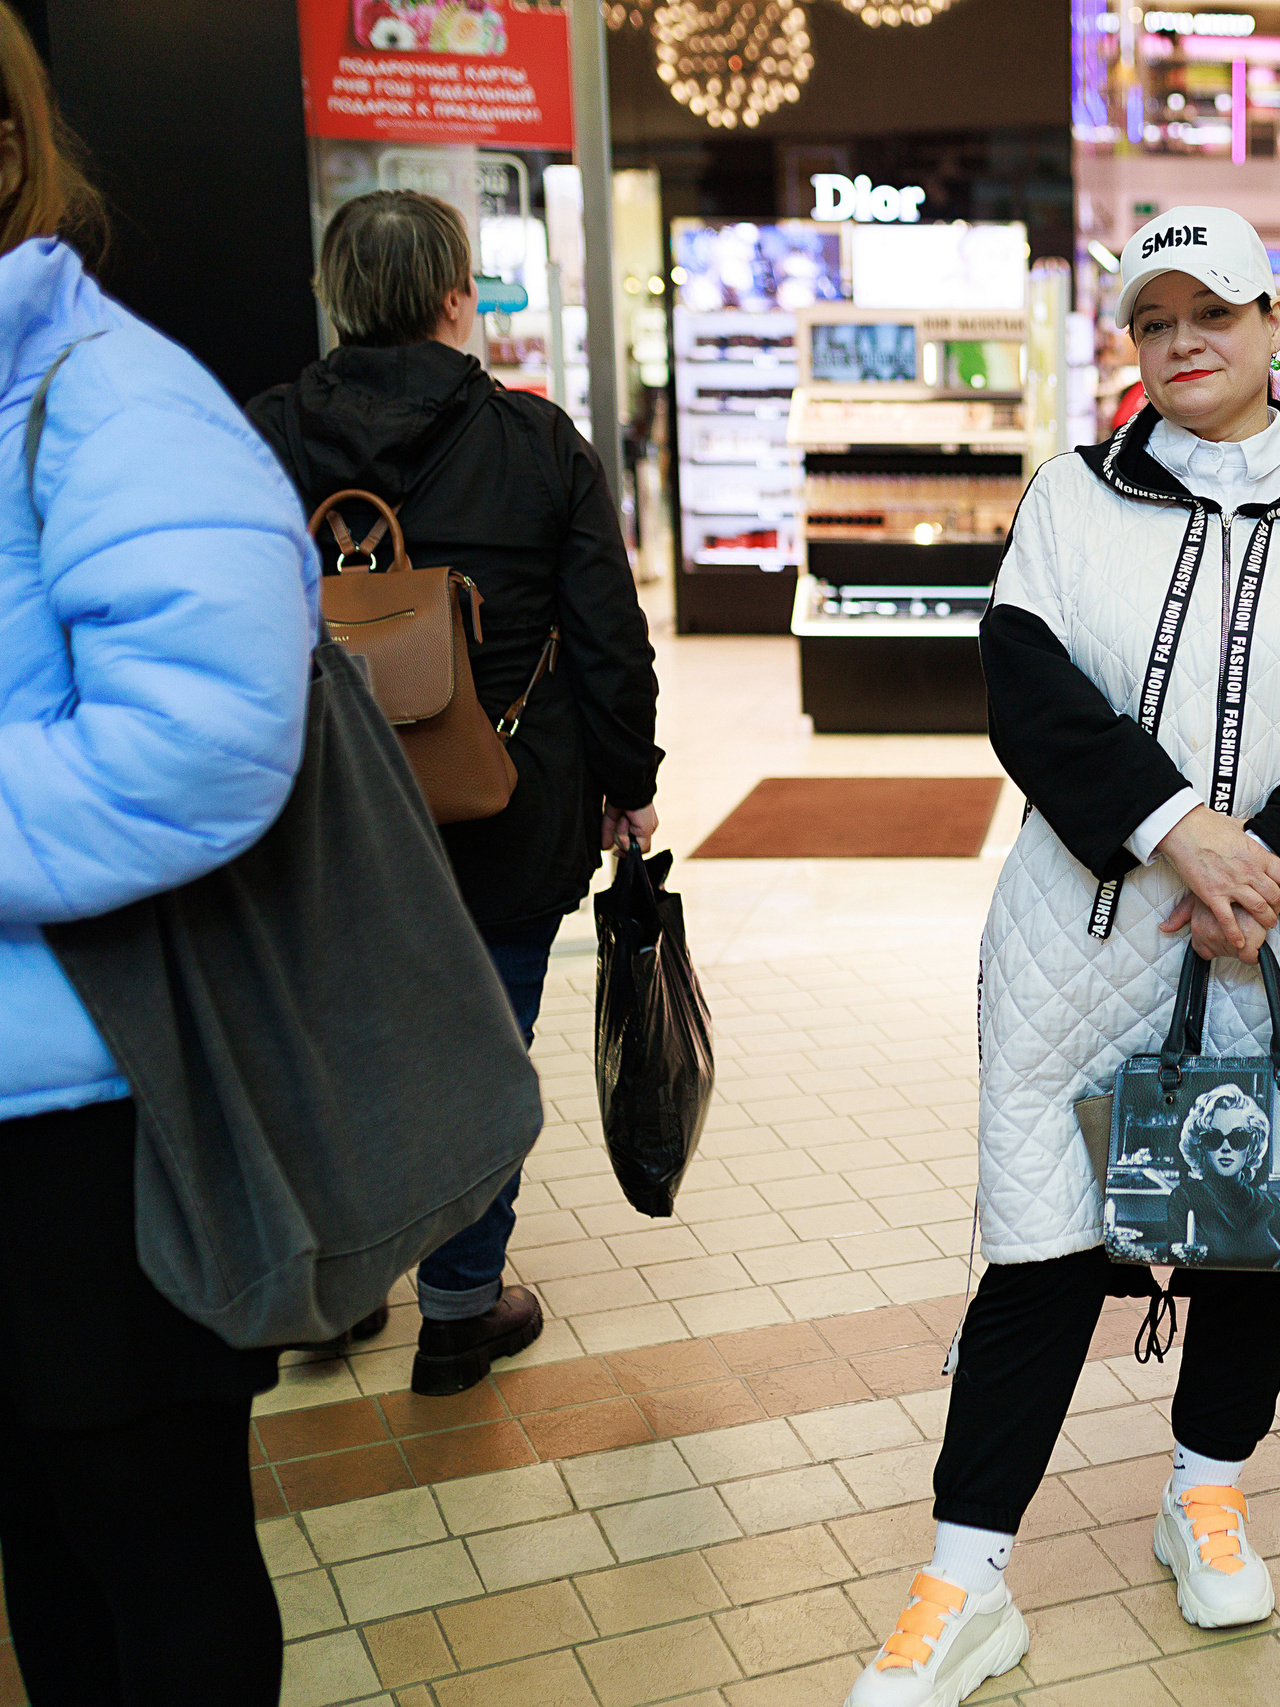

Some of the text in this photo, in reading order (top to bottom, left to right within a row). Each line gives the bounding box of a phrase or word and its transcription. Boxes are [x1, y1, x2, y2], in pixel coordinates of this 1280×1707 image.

[810, 173, 926, 222] Dior
[1115, 477, 1177, 500] FASHION
[1246, 520, 1269, 574] FASHION
[1235, 575, 1258, 632] FASHION
[1141, 667, 1165, 735] FASHION
[1154, 600, 1183, 664] FASHION
[1172, 545, 1199, 598] FASHION
[1226, 636, 1247, 704] FASHION
[1218, 708, 1239, 778] FASHION
